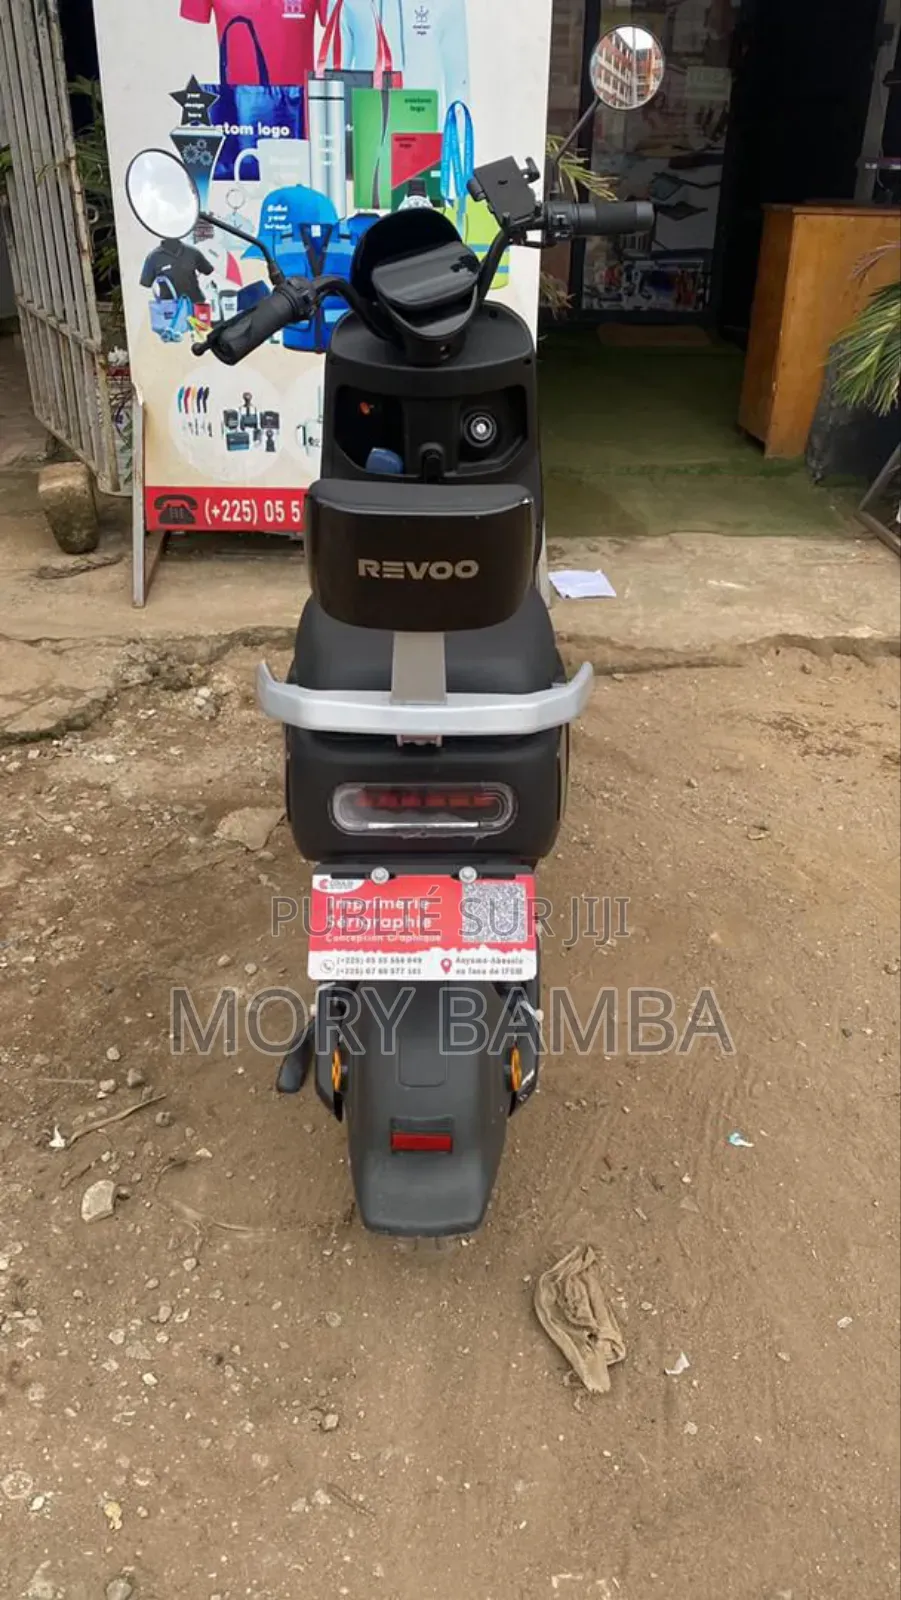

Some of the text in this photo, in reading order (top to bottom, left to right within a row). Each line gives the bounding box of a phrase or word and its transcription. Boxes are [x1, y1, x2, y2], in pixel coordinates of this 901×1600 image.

[257, 121, 290, 138] logo
[204, 498, 303, 525] (+225) 05 5
[358, 558, 479, 580] REVOO
[329, 896, 430, 913] Imprimerie
[326, 914, 433, 932] Sérigraphie
